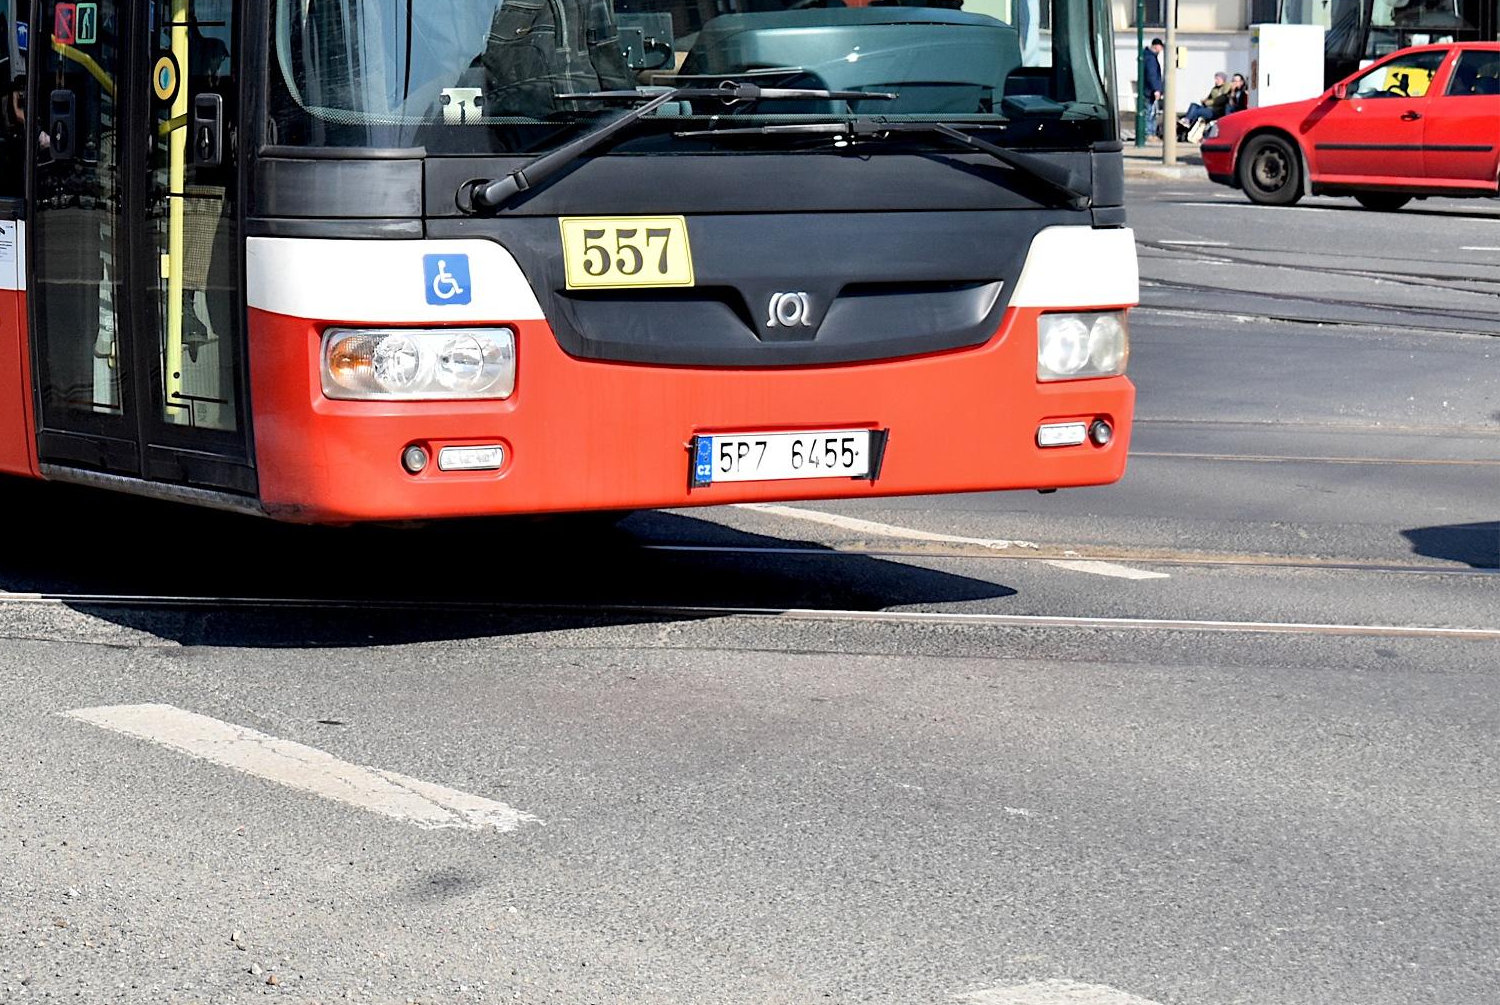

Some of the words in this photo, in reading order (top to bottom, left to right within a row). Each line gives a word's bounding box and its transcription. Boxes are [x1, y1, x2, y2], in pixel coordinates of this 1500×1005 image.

[583, 228, 671, 276] 557
[697, 464, 711, 475] CZ
[720, 441, 767, 473] 5P7
[791, 437, 855, 470] 6455
